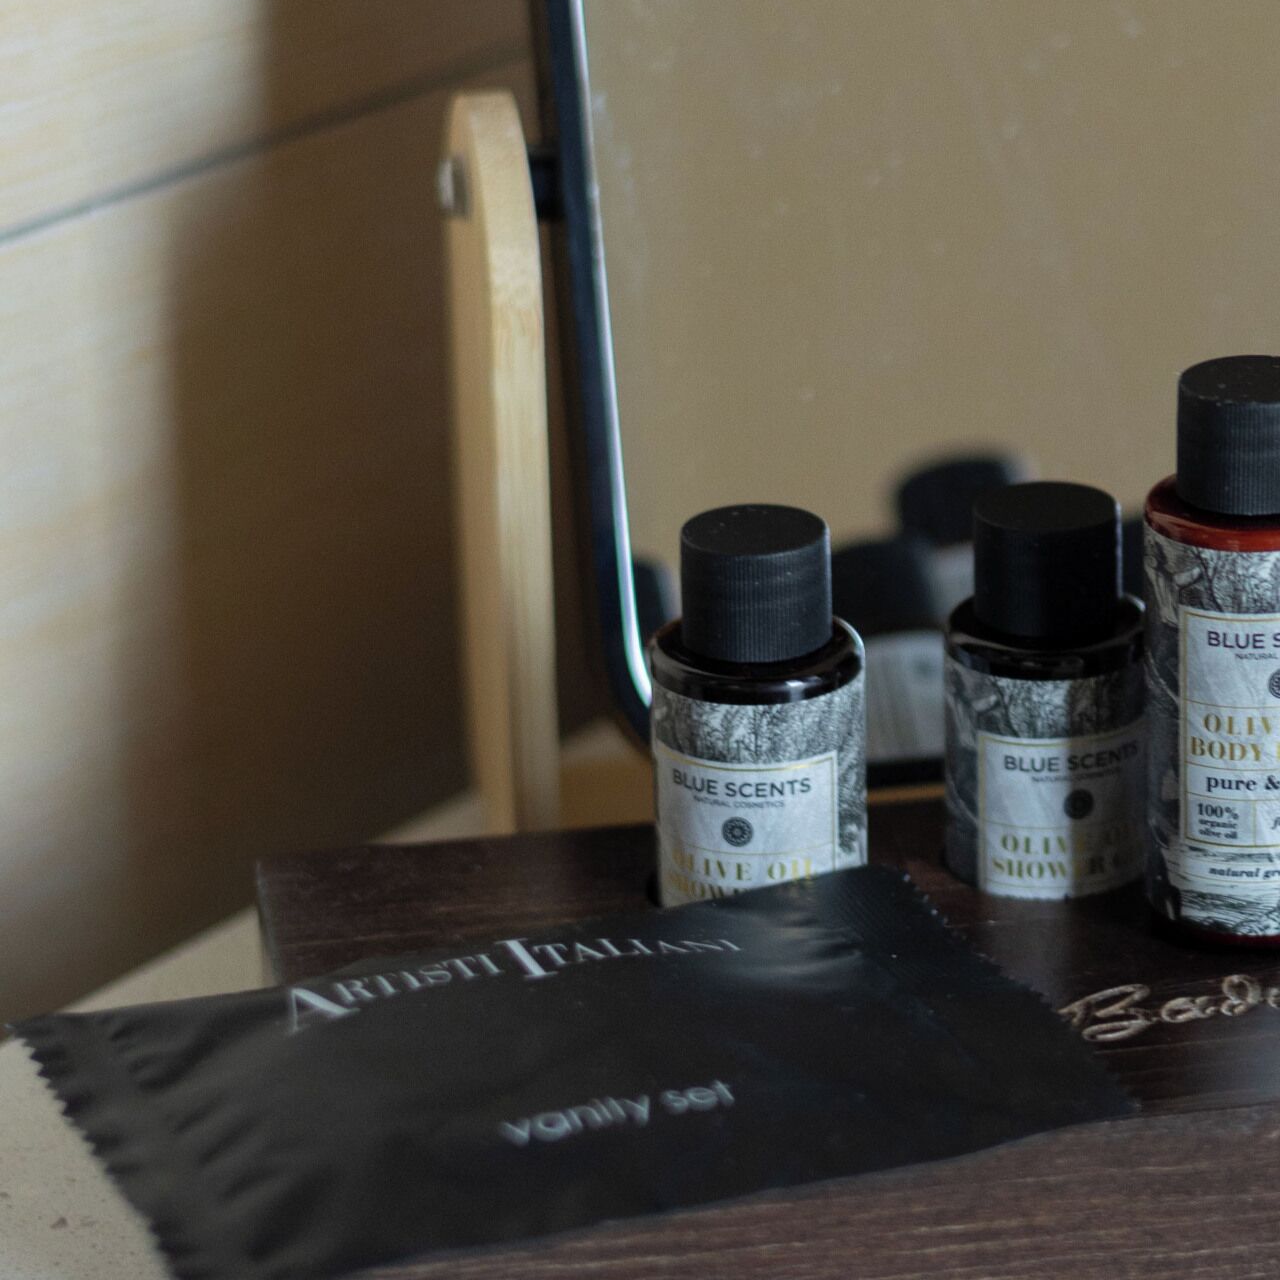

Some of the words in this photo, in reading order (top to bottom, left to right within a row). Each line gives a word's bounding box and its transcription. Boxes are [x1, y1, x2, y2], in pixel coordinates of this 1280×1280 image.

[1207, 629, 1266, 650] BLUE
[1234, 652, 1278, 661] NATURAL
[1003, 754, 1061, 773] BLUE
[1067, 740, 1139, 771] SCENTS
[1190, 735, 1263, 762] BODY
[671, 769, 719, 796] BLUE
[724, 776, 812, 799] SCENTS
[1205, 775, 1258, 793] pure
[1196, 802, 1240, 820] 100%
[502, 1094, 651, 1147] vanity
[660, 1079, 737, 1115] set
